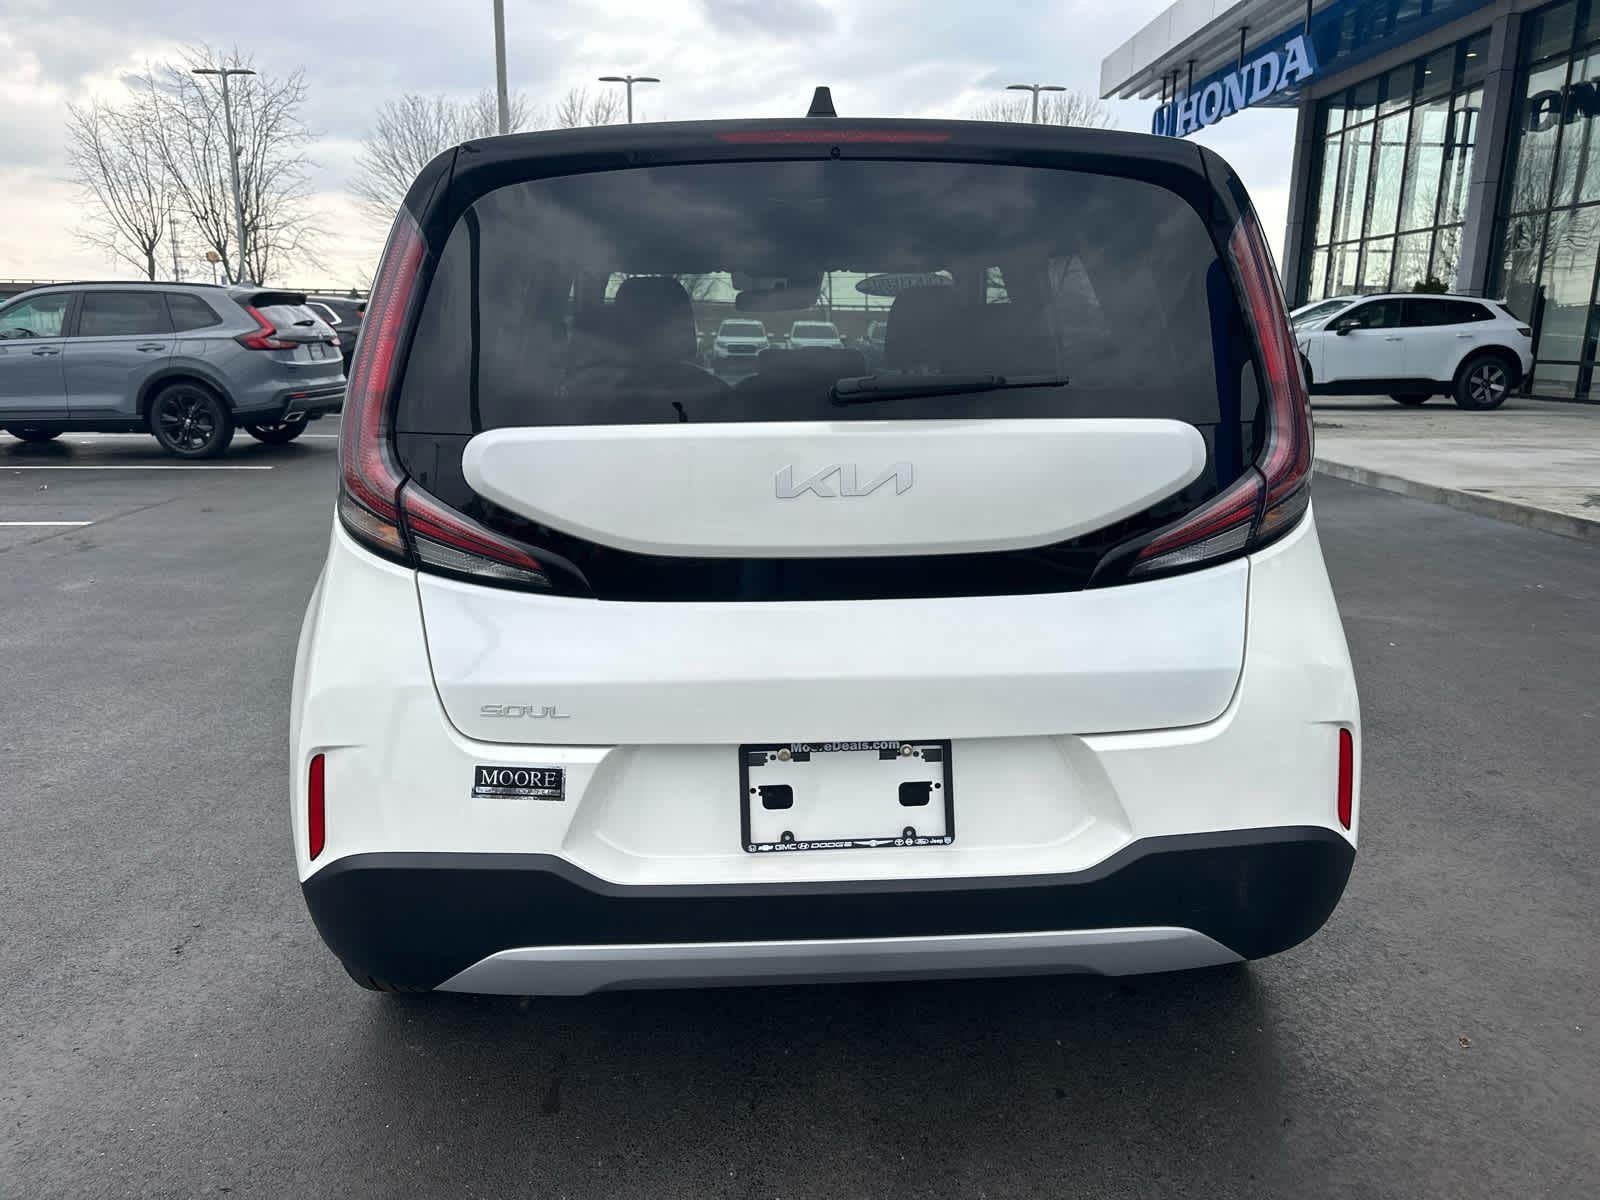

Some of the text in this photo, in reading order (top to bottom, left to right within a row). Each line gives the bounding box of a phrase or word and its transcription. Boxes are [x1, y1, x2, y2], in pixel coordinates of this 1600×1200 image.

[1175, 34, 1314, 138] HONDA
[775, 462, 913, 499] KIA
[480, 704, 570, 719] SOUL
[790, 741, 900, 753] MoeDeals.com
[480, 769, 556, 787] MOORE
[774, 843, 797, 851] GMC
